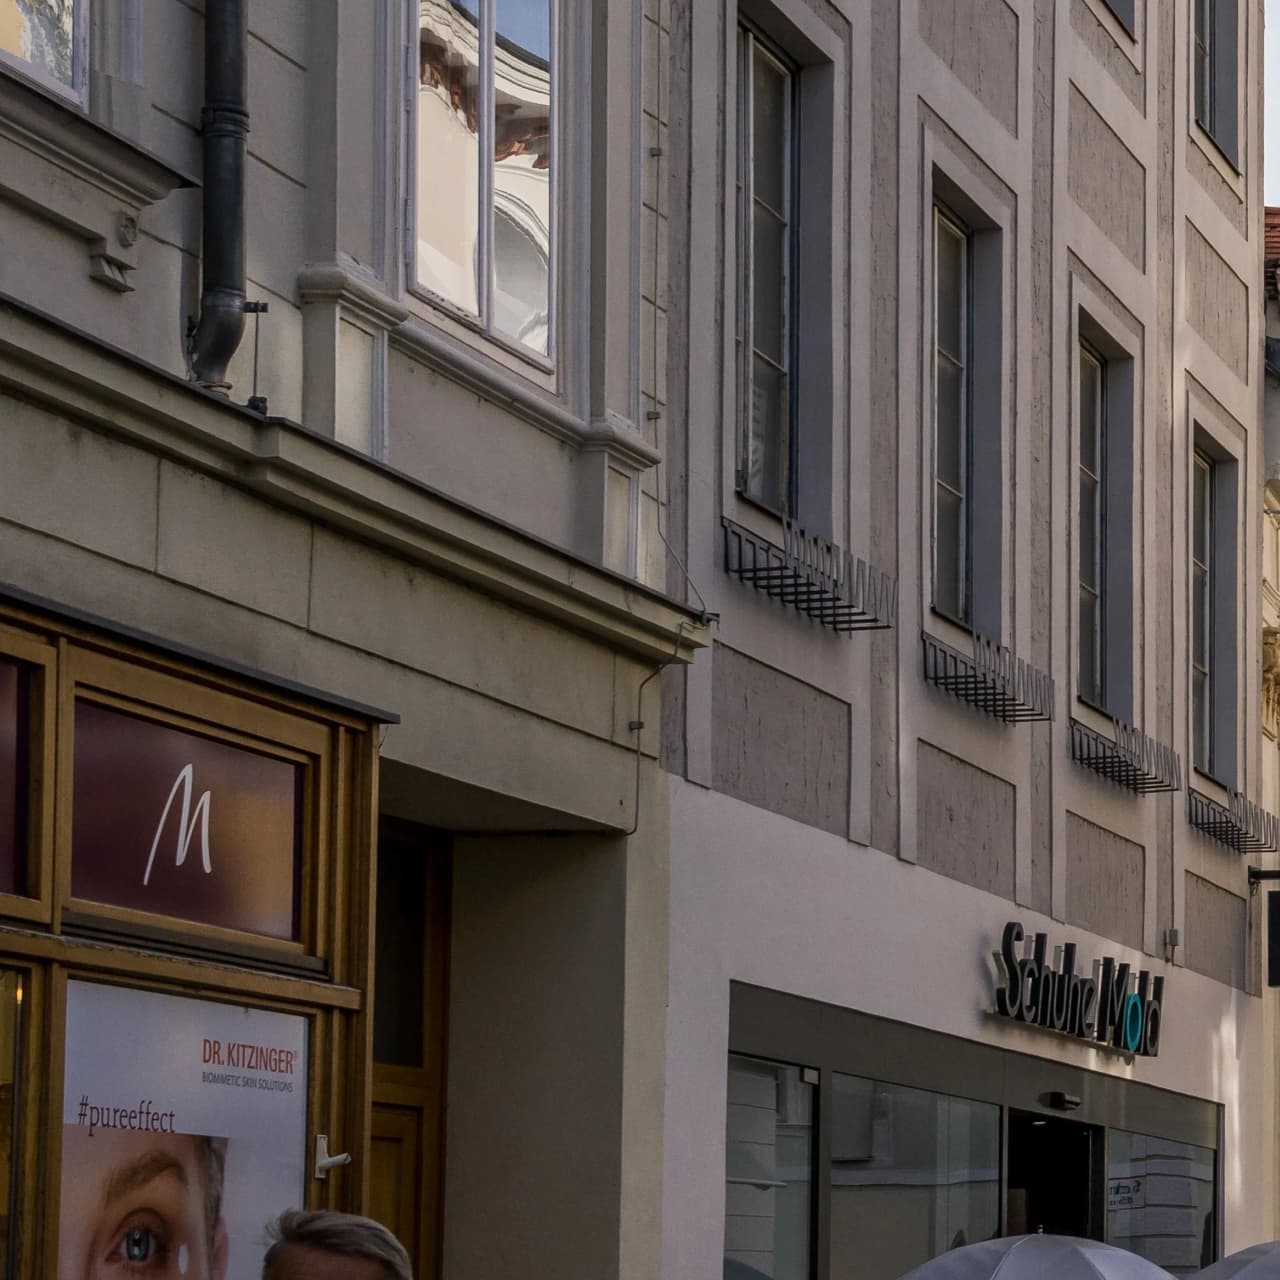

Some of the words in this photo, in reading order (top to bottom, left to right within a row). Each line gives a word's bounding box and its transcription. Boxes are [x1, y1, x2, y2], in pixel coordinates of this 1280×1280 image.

[996, 921, 1097, 1038] Schuhe
[1097, 957, 1165, 1057] Mold
[202, 1039, 224, 1066] DR.
[227, 1042, 294, 1075] KITZINGER
[78, 1095, 177, 1137] #pureeffect
